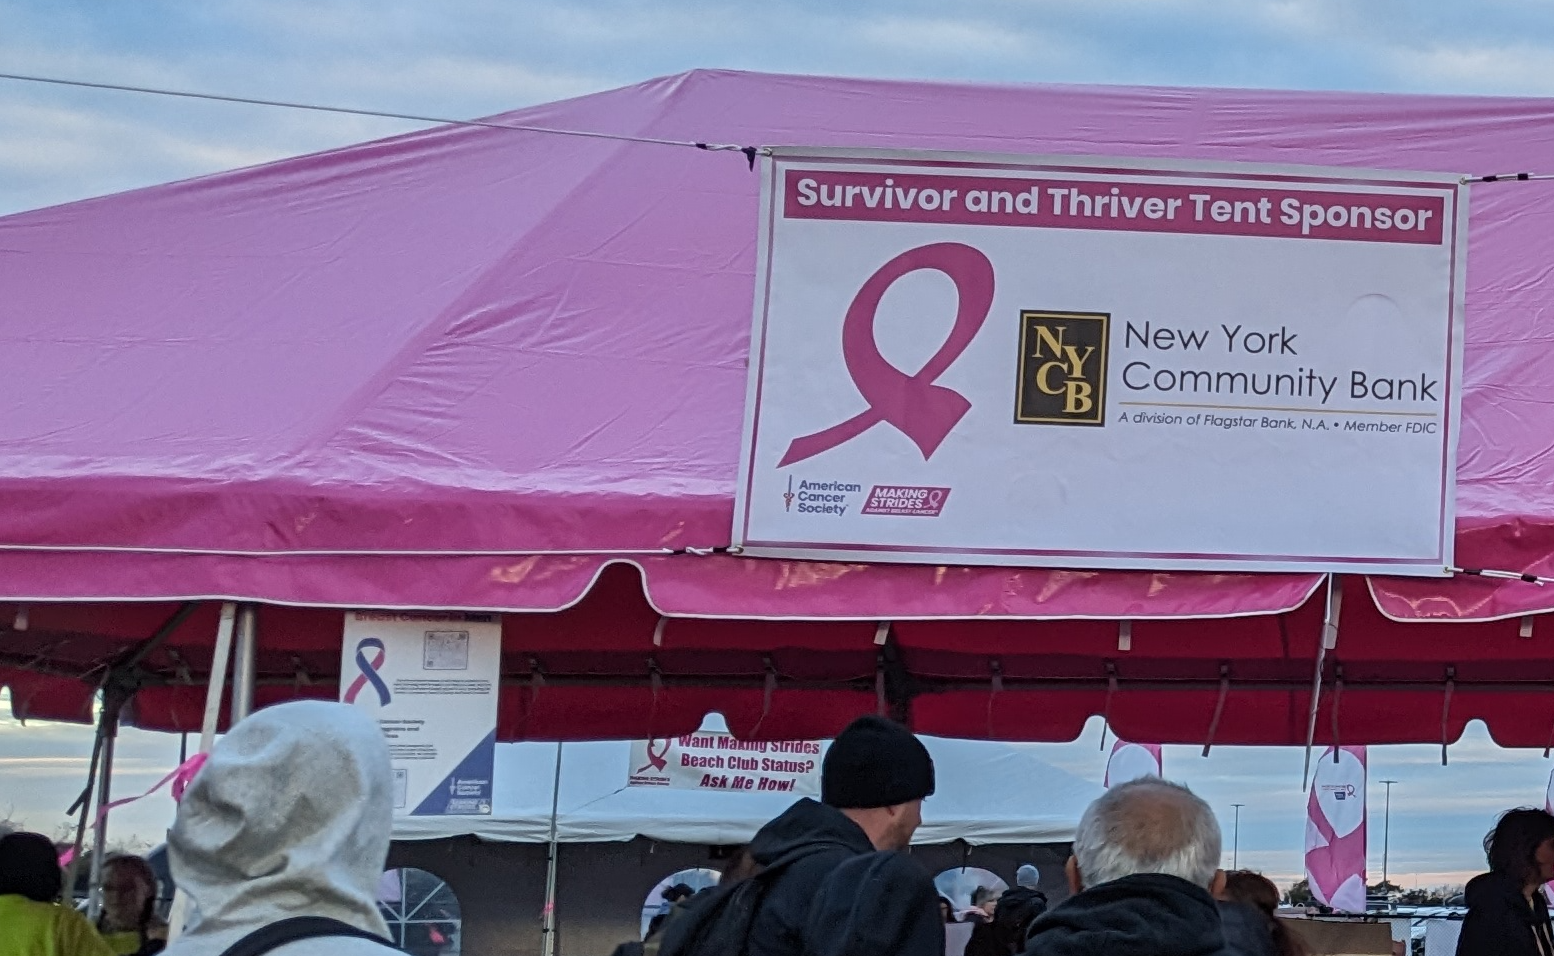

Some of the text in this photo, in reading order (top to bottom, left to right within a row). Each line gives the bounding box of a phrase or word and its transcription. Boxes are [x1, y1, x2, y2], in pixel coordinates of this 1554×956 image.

[797, 178, 1433, 235] Survivor and Thriver Tent Sponsor
[1125, 320, 1298, 355] New York
[1122, 361, 1438, 404] Community Bank
[1118, 412, 1437, 434] A division of Flagstar Bank, N.A. Member FDIC
[799, 480, 861, 492] American
[874, 487, 928, 499] MAKING
[797, 491, 846, 503] Cancer
[869, 498, 924, 509] STRIDES
[797, 503, 847, 517] Society
[678, 734, 715, 749] Want
[681, 753, 815, 773] Beach Club Status?
[699, 774, 796, 792] Ask Me How!
